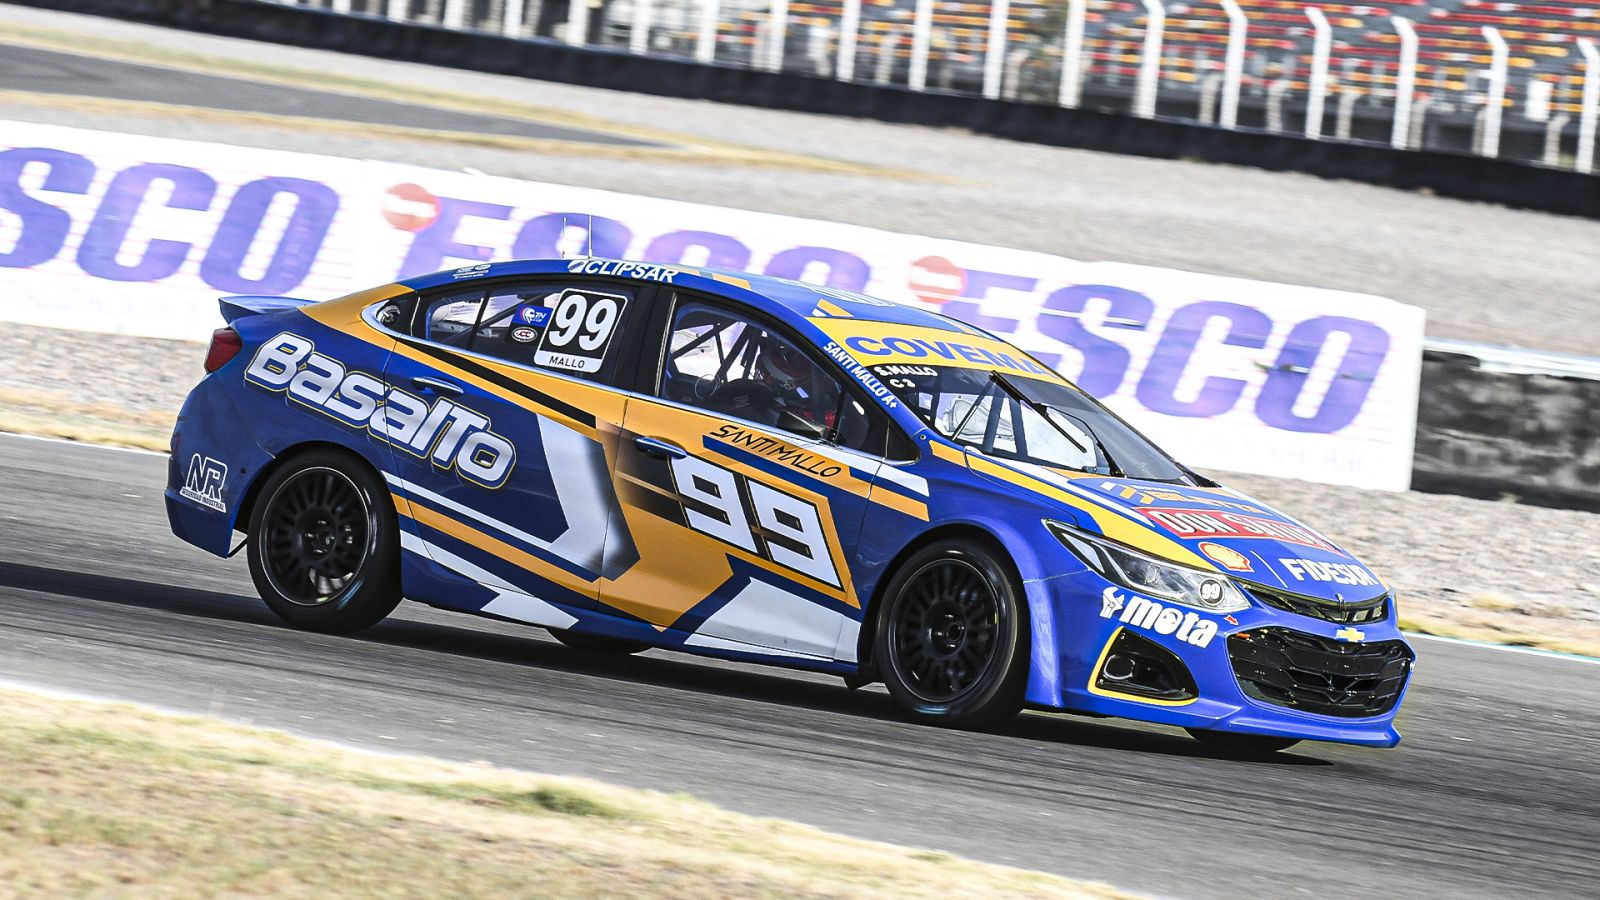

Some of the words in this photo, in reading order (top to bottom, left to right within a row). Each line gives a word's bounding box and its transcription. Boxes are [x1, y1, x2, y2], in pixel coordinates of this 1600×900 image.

[584, 260, 680, 283] CLIPSAR
[548, 294, 618, 351] 99
[548, 354, 586, 369] MALLO
[823, 341, 857, 371] SANTI
[850, 365, 889, 397] MALLO
[940, 268, 1391, 433] ESCO
[670, 453, 843, 588] 99
[1148, 510, 1241, 534] DON
[1202, 583, 1220, 600] 99
[1118, 595, 1219, 649] mota
